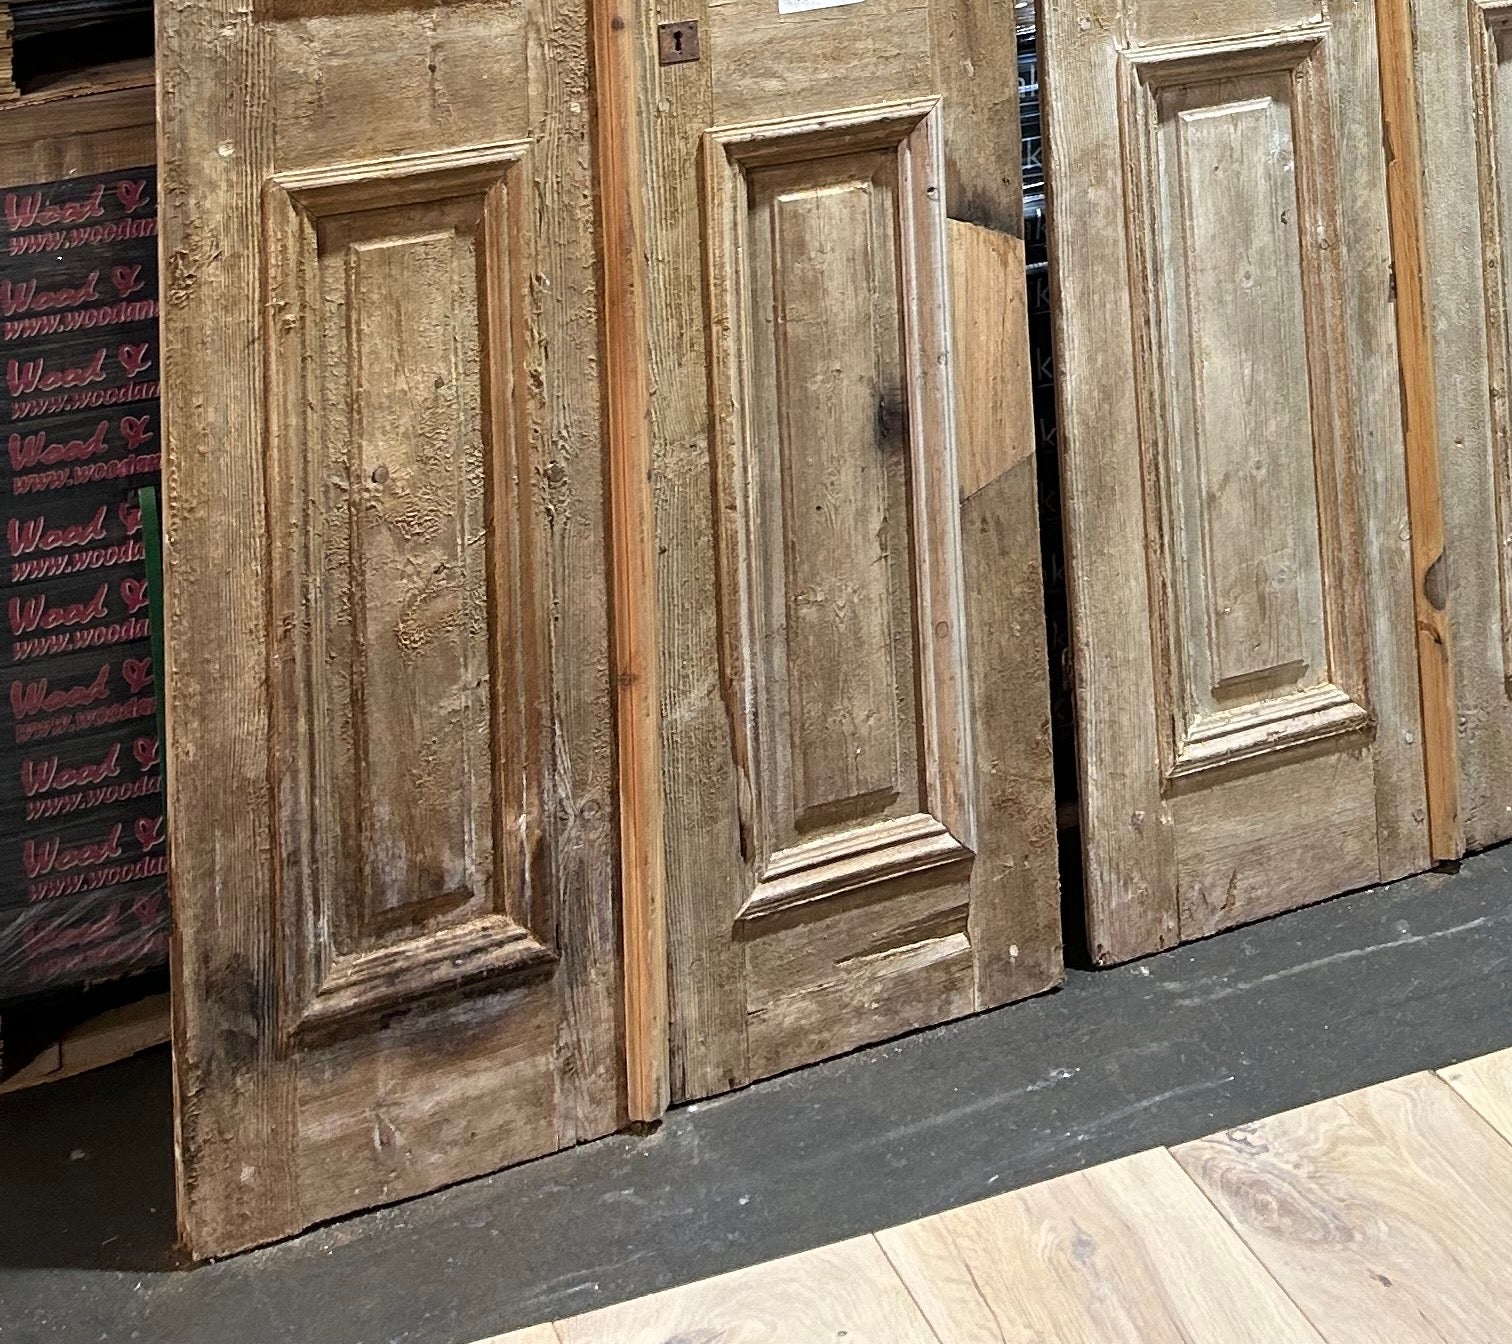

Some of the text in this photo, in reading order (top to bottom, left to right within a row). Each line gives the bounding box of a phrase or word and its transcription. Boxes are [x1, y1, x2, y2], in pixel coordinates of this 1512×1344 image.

[4, 184, 105, 231] Wood
[6, 349, 107, 397] Wood
[8, 421, 109, 471] Wood
[6, 506, 108, 556] Wood
[8, 585, 107, 635] Wood
[10, 664, 111, 719] Wood
[21, 742, 120, 796] Wood
[23, 823, 122, 878] Wood
